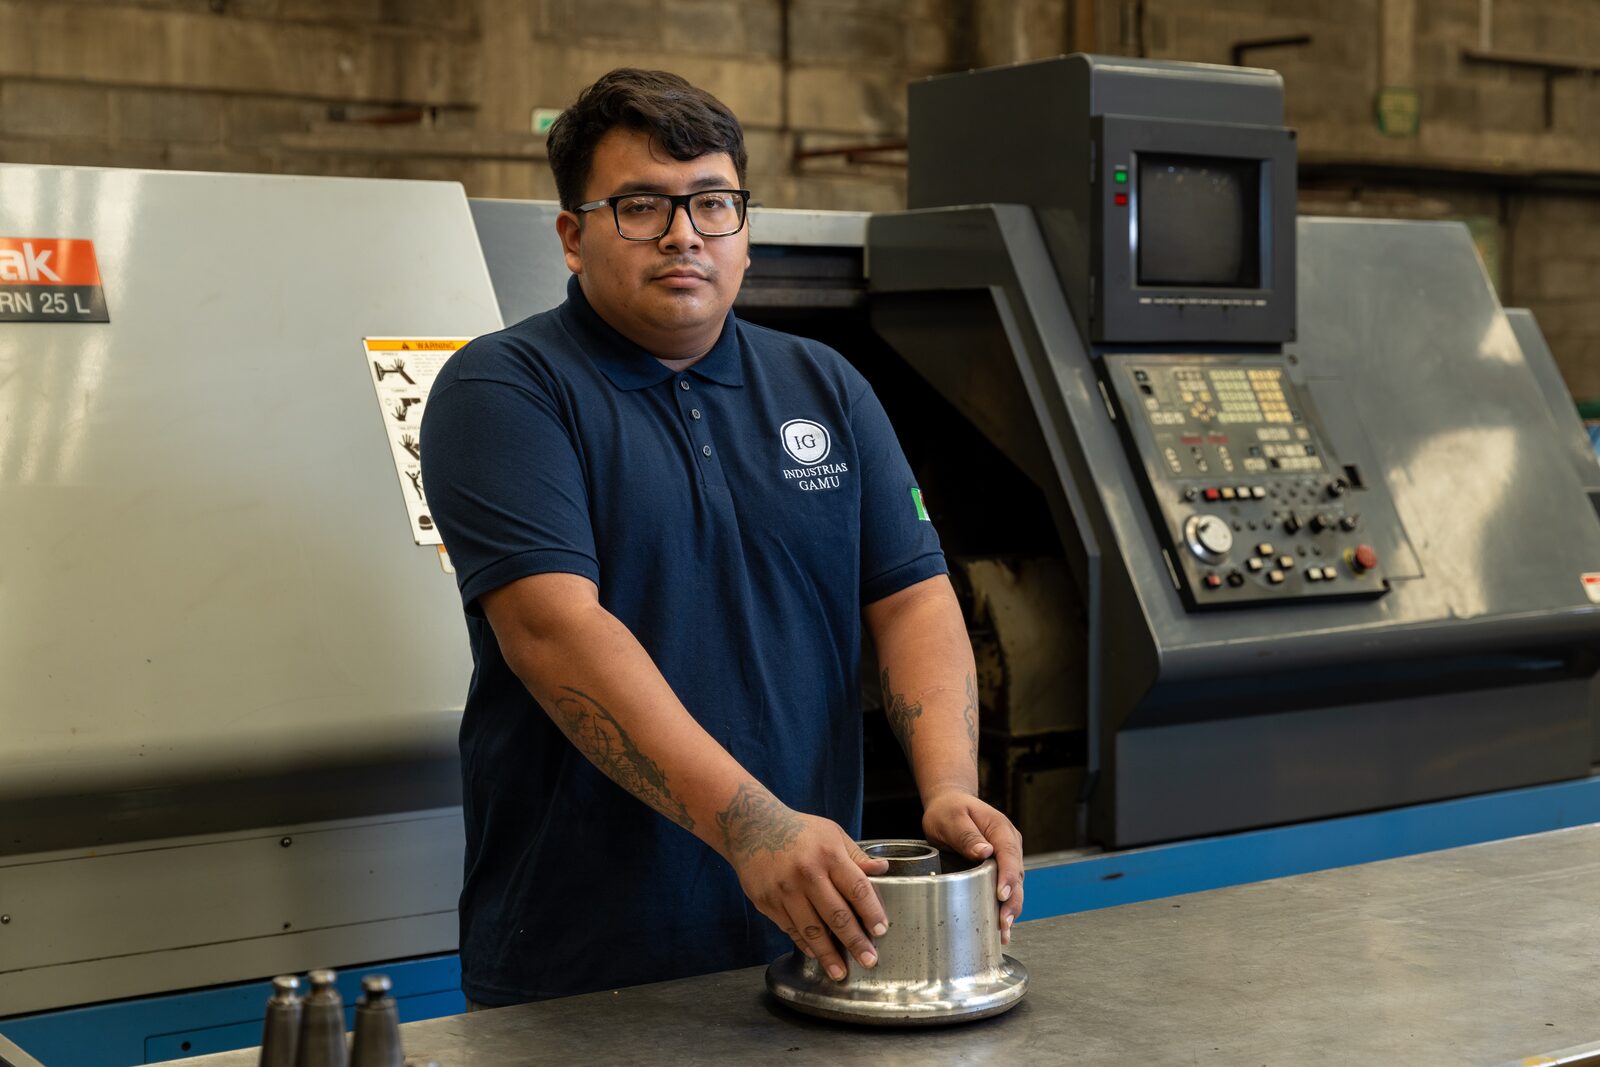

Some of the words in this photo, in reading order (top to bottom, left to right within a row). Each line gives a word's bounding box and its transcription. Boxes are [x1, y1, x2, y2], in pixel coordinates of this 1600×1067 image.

[40, 292, 68, 314] 25
[73, 292, 91, 314] L
[416, 341, 456, 350] WARNING
[794, 434, 816, 450] IG
[783, 463, 848, 479] INDUSTRIAS
[799, 476, 840, 490] GAMU
